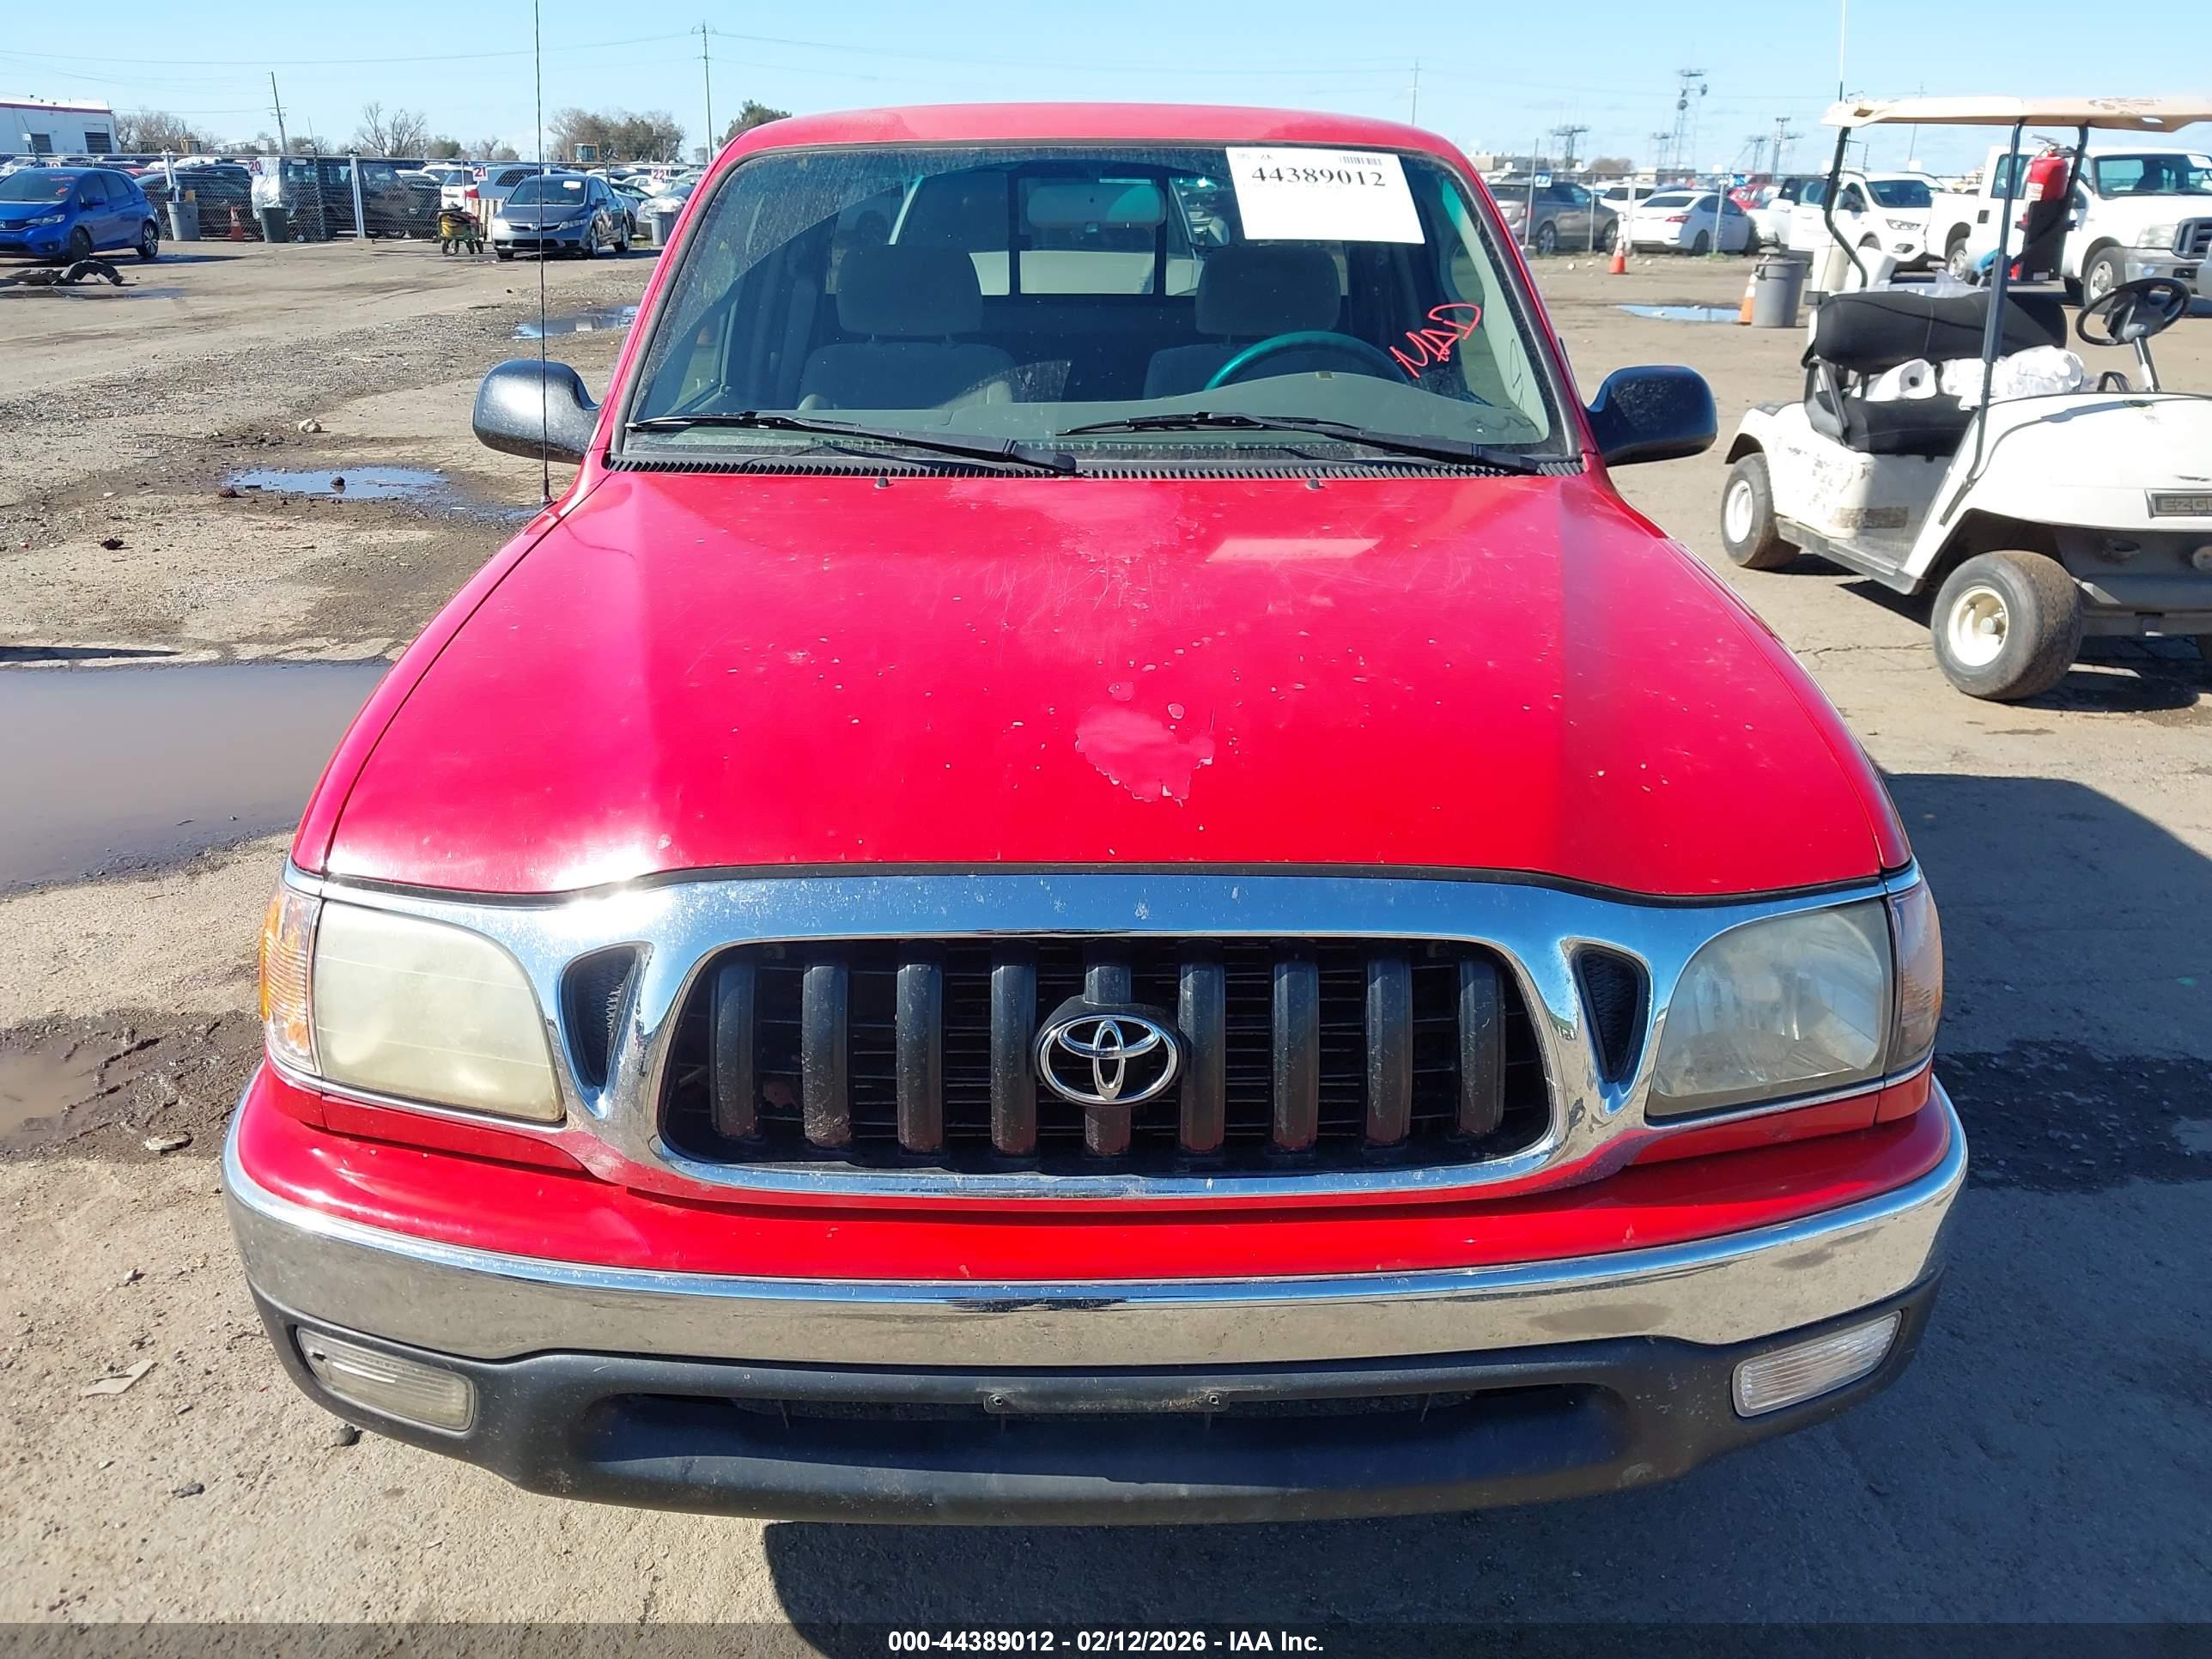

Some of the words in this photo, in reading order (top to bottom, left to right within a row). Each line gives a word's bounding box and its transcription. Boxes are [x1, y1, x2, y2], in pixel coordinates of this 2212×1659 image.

[248, 161, 261, 172] 20
[473, 167, 486, 177] 21
[1251, 167, 1386, 186] 44389012
